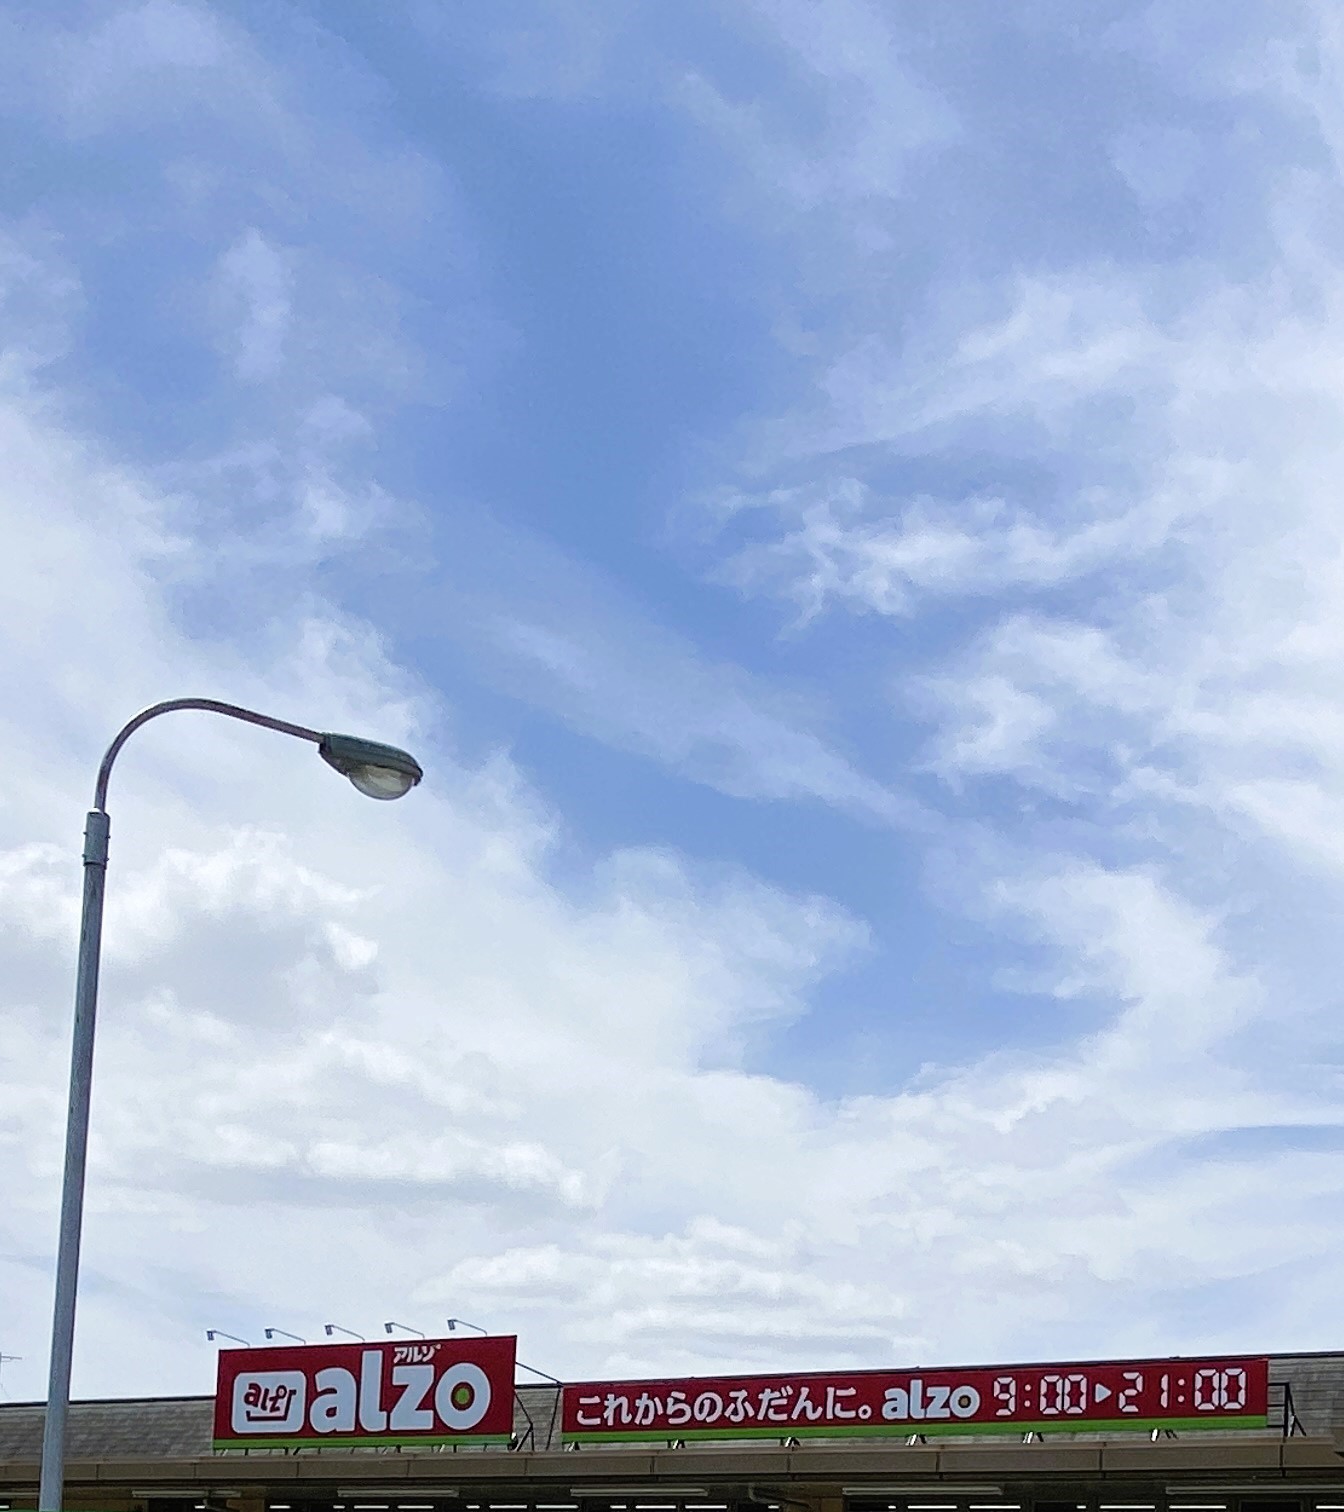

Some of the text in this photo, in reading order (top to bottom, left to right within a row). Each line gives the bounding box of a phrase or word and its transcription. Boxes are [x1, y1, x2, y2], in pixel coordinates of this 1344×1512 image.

[393, 1343, 442, 1364] アルゾ
[309, 1349, 492, 1433] alzo
[576, 1385, 872, 1427] これからのふだんに。
[881, 1379, 981, 1420] alzo
[992, 1374, 1089, 1416] 9:00
